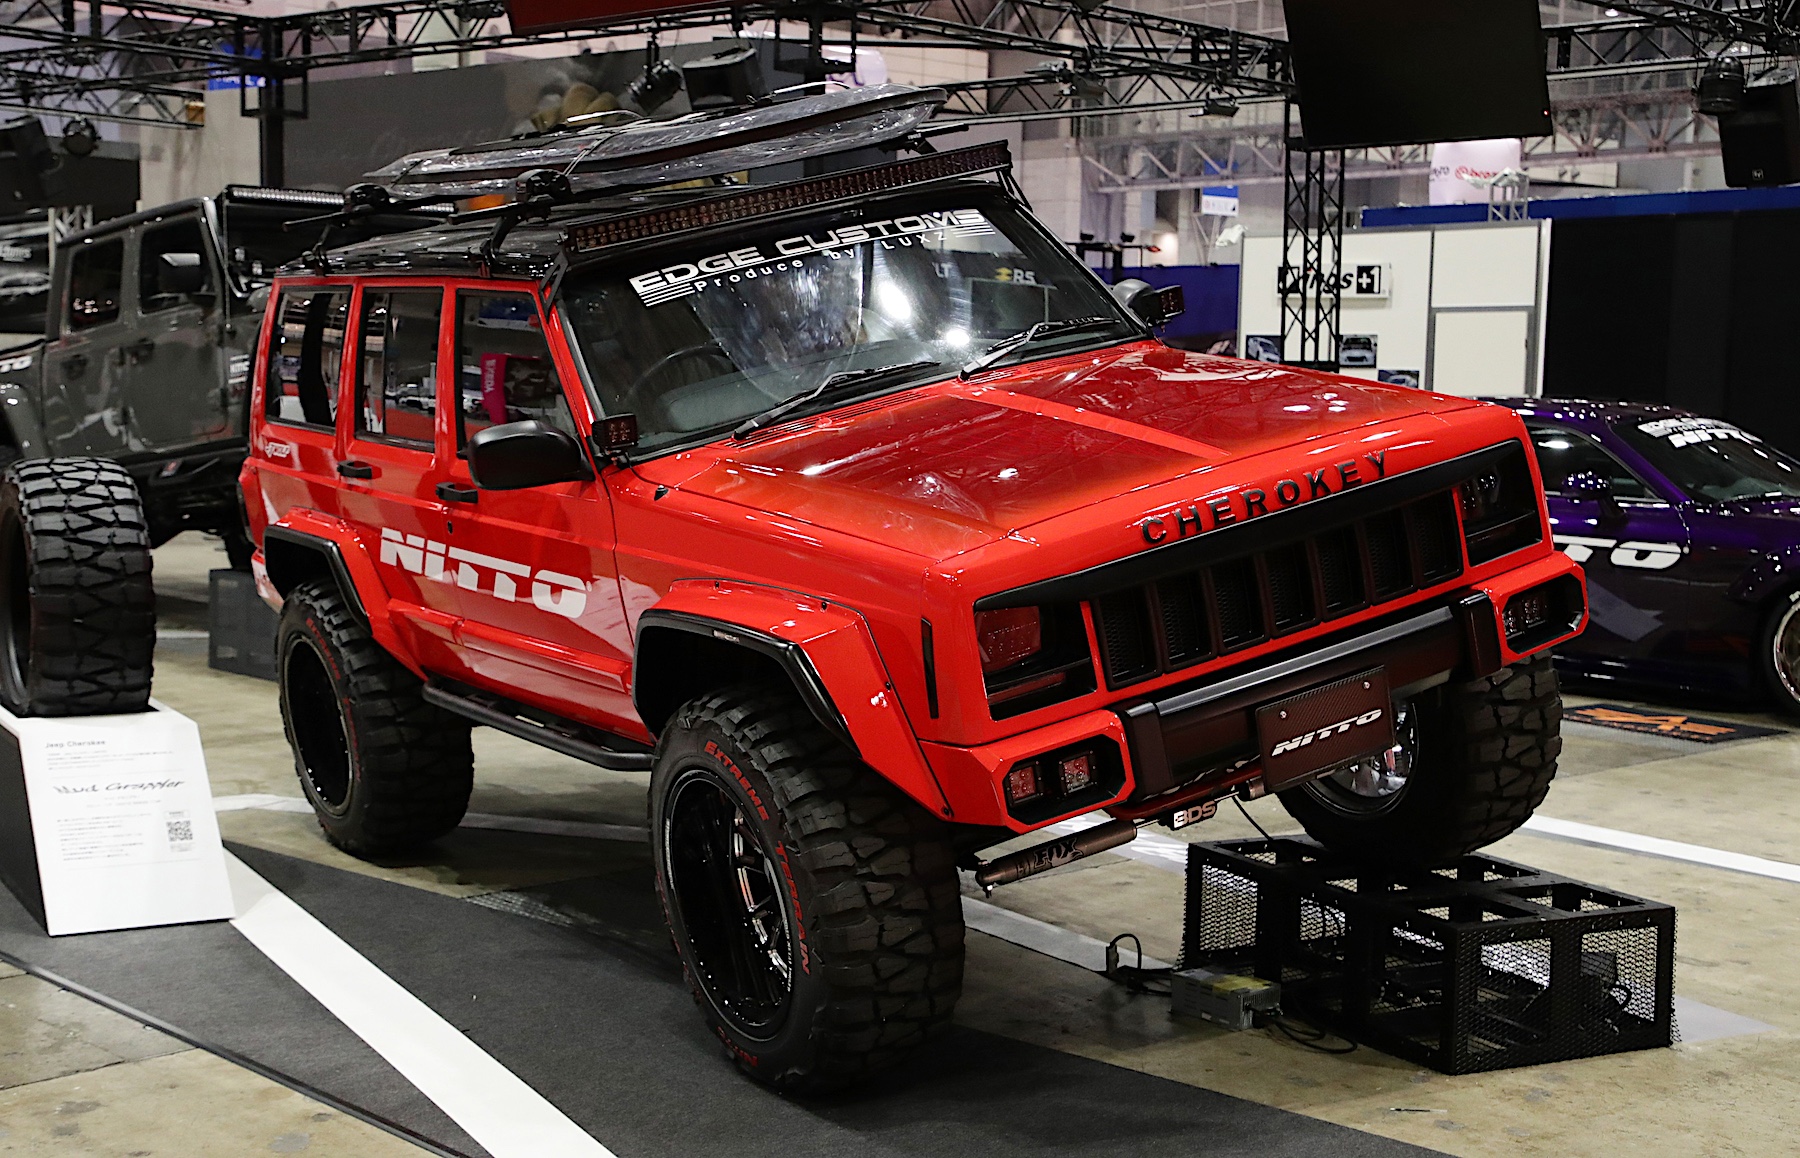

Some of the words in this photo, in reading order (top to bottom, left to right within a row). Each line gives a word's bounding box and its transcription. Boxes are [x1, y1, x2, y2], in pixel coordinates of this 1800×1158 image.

[629, 246, 766, 294] EDGE
[775, 209, 986, 256] CUSTOMS
[693, 258, 804, 292] Produce
[828, 248, 856, 260] by
[881, 231, 948, 250] LUXZ
[1140, 451, 1387, 544] CHEROKEY
[380, 527, 593, 619] NITTO
[1271, 709, 1382, 756] NITTO
[1173, 801, 1216, 829] BDS
[704, 739, 769, 821] EXTREME
[775, 840, 811, 976] TERRAIN
[1033, 836, 1083, 871] FOX
